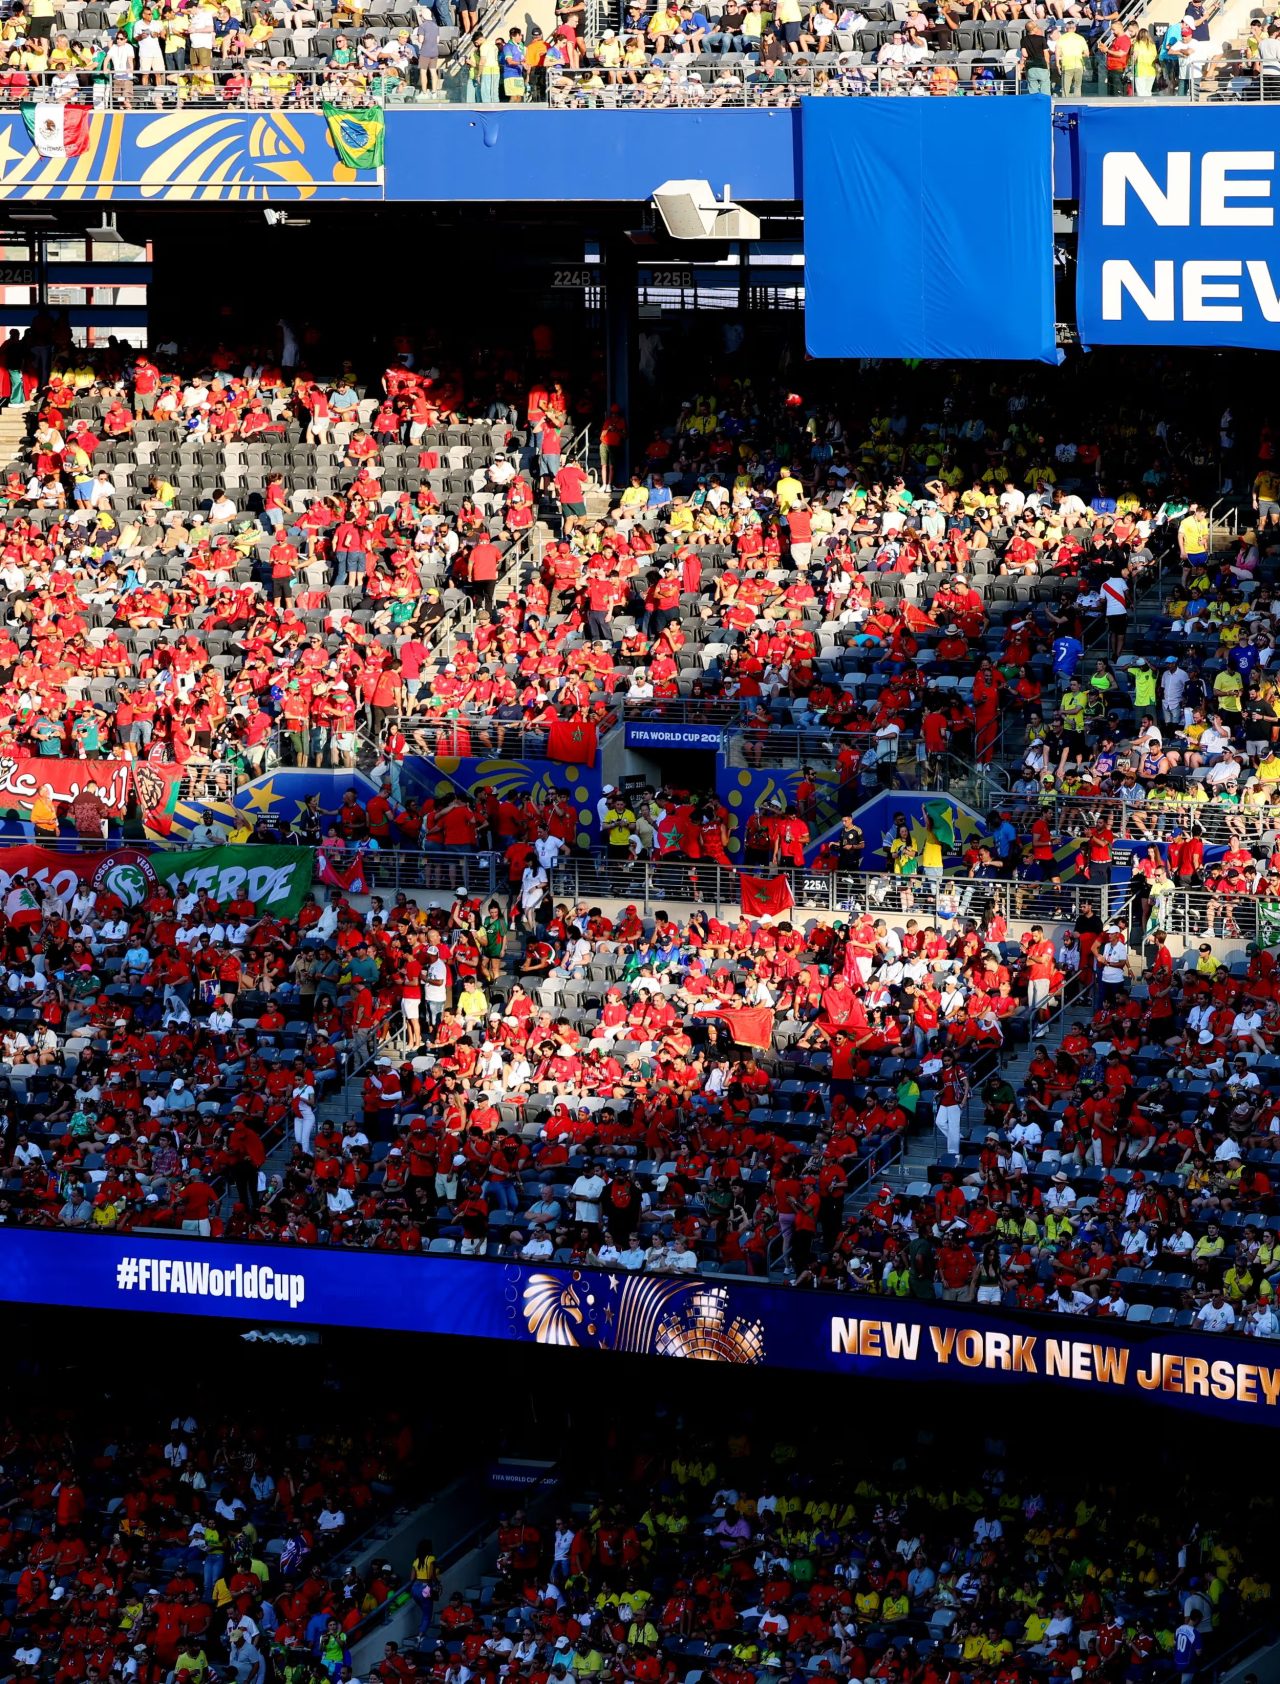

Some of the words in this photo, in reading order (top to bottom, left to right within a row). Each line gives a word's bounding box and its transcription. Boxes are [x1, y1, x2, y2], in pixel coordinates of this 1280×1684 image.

[554, 271, 591, 286] 224B
[654, 272, 692, 286] 225B
[1058, 646, 1067, 662] 7
[1239, 656, 1249, 669] 3
[631, 731, 649, 740] FIFA
[650, 732, 681, 741] WORLD
[683, 733, 700, 742] CUP
[93, 858, 115, 888] ROSSO
[136, 855, 156, 882] VERDE
[166, 862, 297, 904] VERDE
[803, 879, 829, 891] 225A
[117, 1258, 305, 1309] #FIFAWorldCup
[832, 1316, 920, 1360] NEW
[929, 1326, 1037, 1374] YORK
[1046, 1339, 1129, 1384] NEW
[1177, 1632, 1187, 1653] 10
